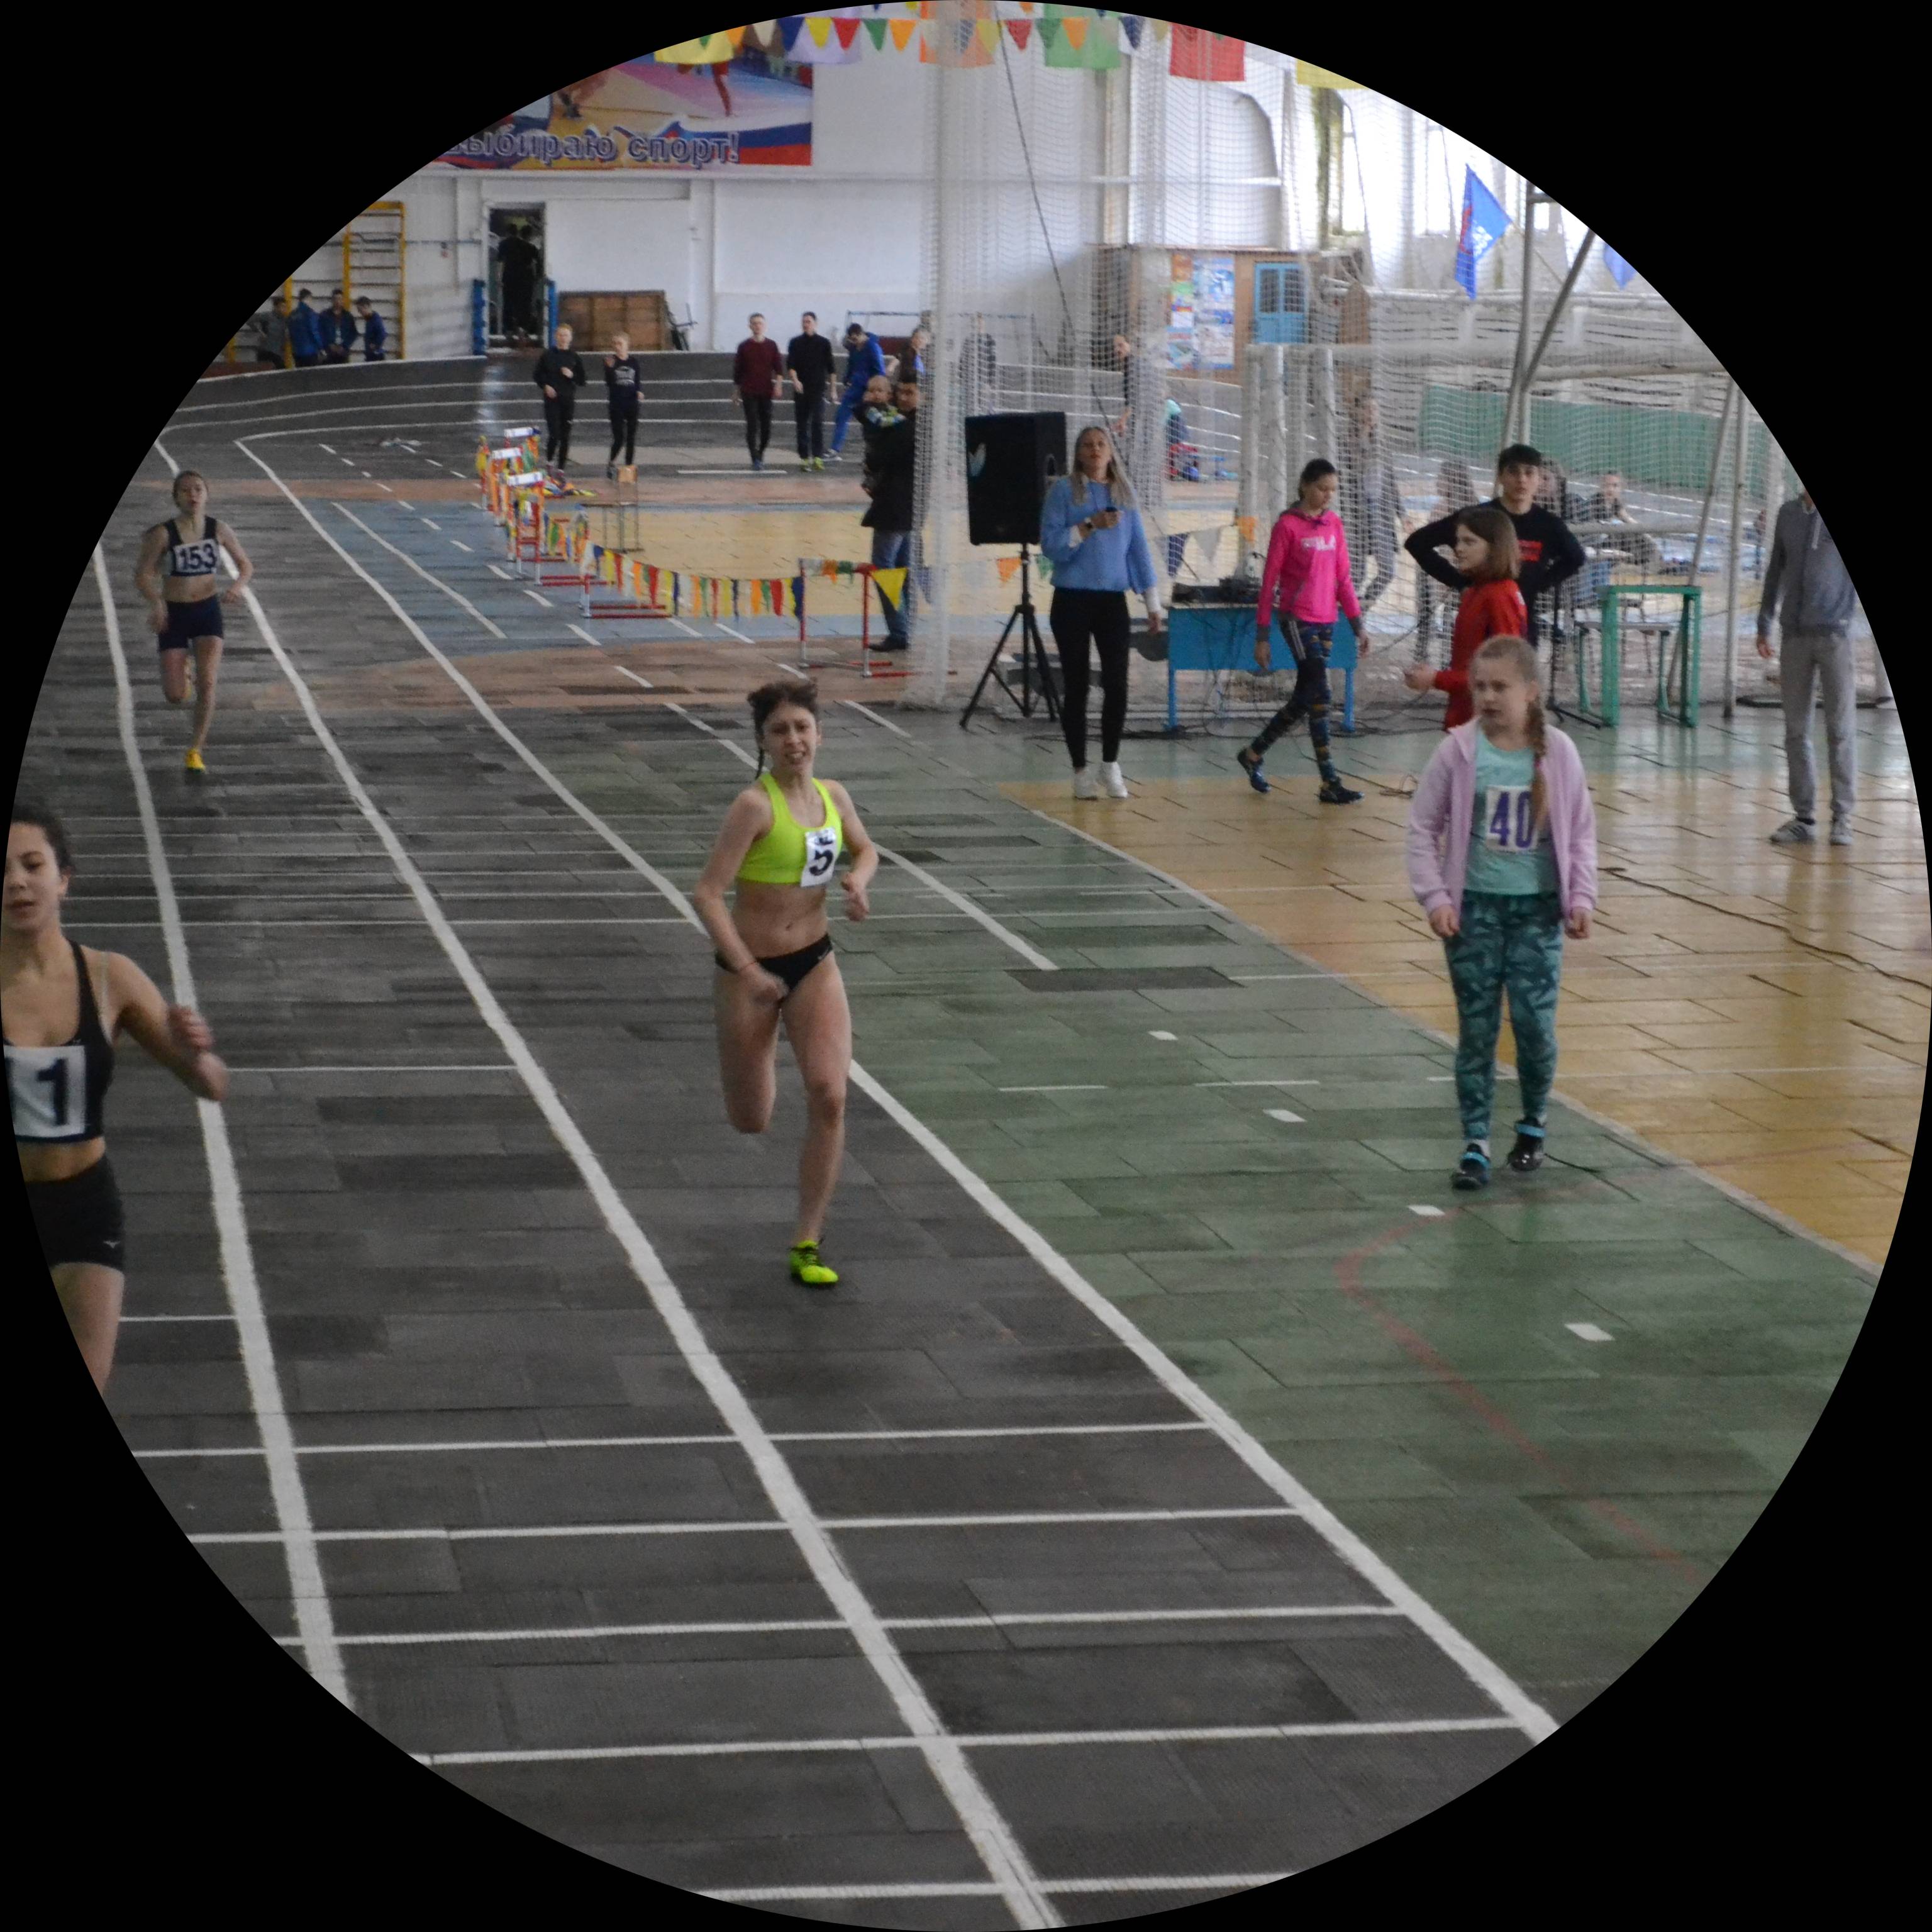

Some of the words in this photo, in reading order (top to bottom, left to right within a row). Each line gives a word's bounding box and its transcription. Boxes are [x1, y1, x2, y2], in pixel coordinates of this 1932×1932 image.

[628, 130, 740, 170] спорт!
[179, 543, 217, 570] 153
[1490, 791, 1533, 848] 40
